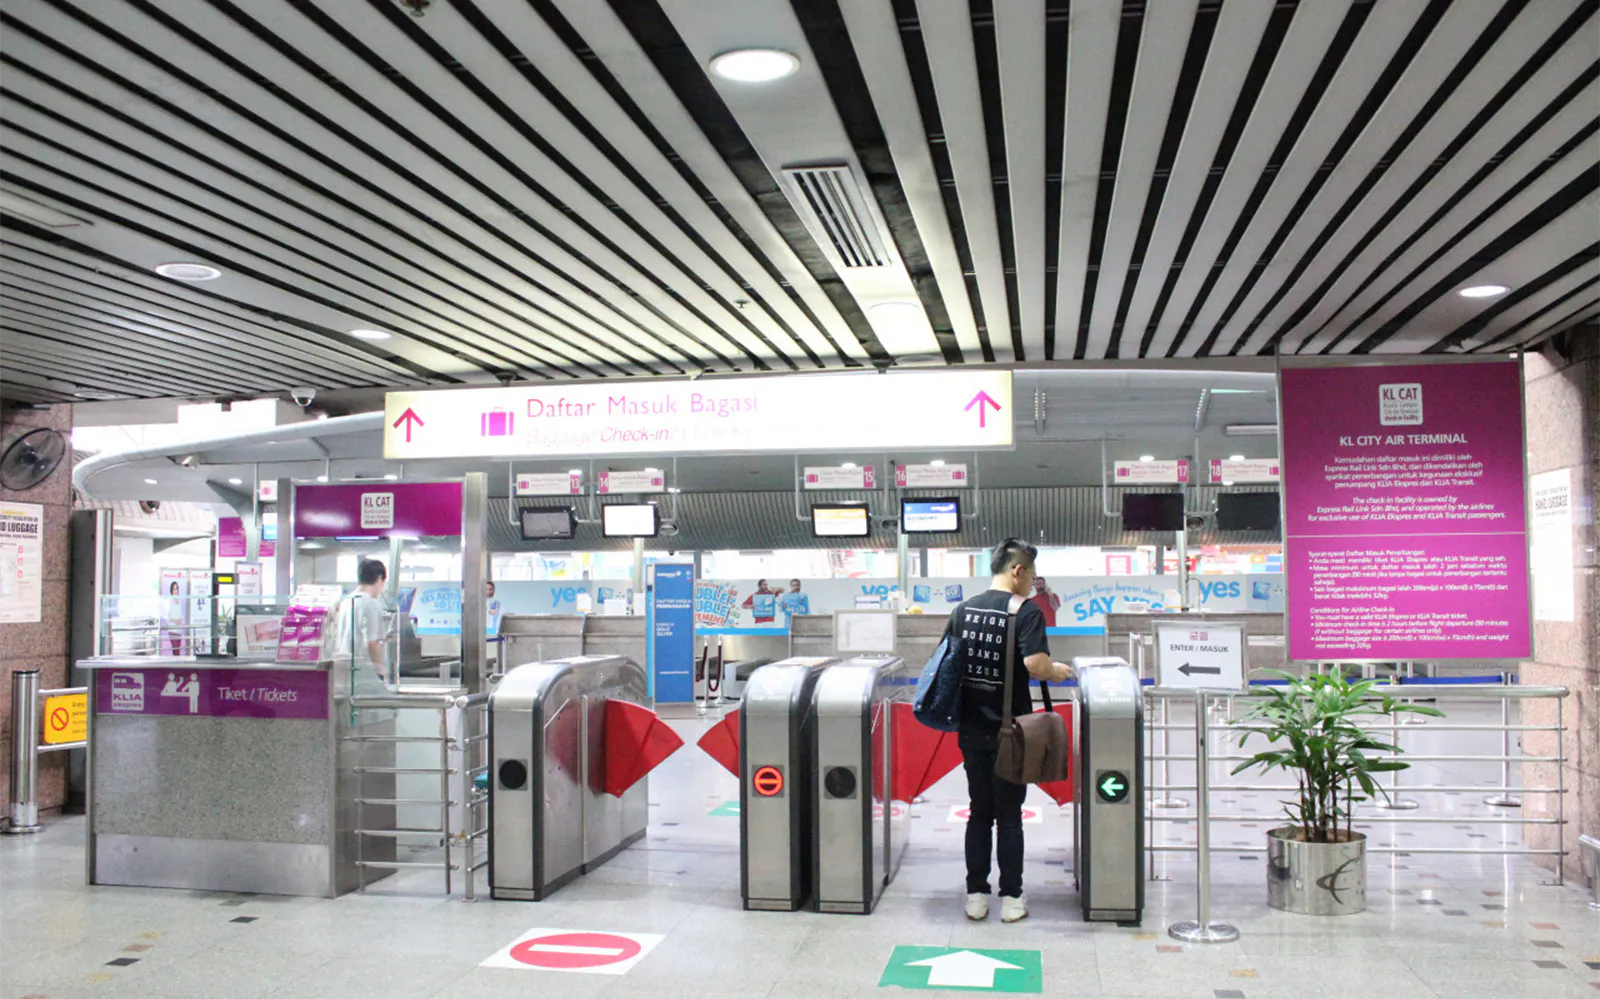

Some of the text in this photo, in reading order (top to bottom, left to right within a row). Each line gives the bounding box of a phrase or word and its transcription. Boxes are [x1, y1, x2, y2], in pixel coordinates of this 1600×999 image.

[1383, 388, 1417, 400] KL CAT
[527, 393, 757, 418] Daftar Masuk Bagasi
[1339, 434, 1468, 446] KL CITY AIR TERMINAL
[864, 471, 873, 482] 15
[897, 470, 906, 482] 16
[1178, 466, 1187, 476] 17
[1212, 465, 1221, 476] 18
[571, 478, 580, 489] 13
[600, 477, 608, 488] 14
[364, 496, 390, 507] KL CAT
[8, 522, 38, 534] LUGGAGE
[1200, 581, 1240, 604] yes
[1073, 596, 1115, 621] SAY
[965, 613, 1006, 627] NEIGH
[1200, 645, 1229, 653] MASUK
[113, 693, 142, 701] KLIA
[218, 686, 297, 702] Tiket / Tickets
